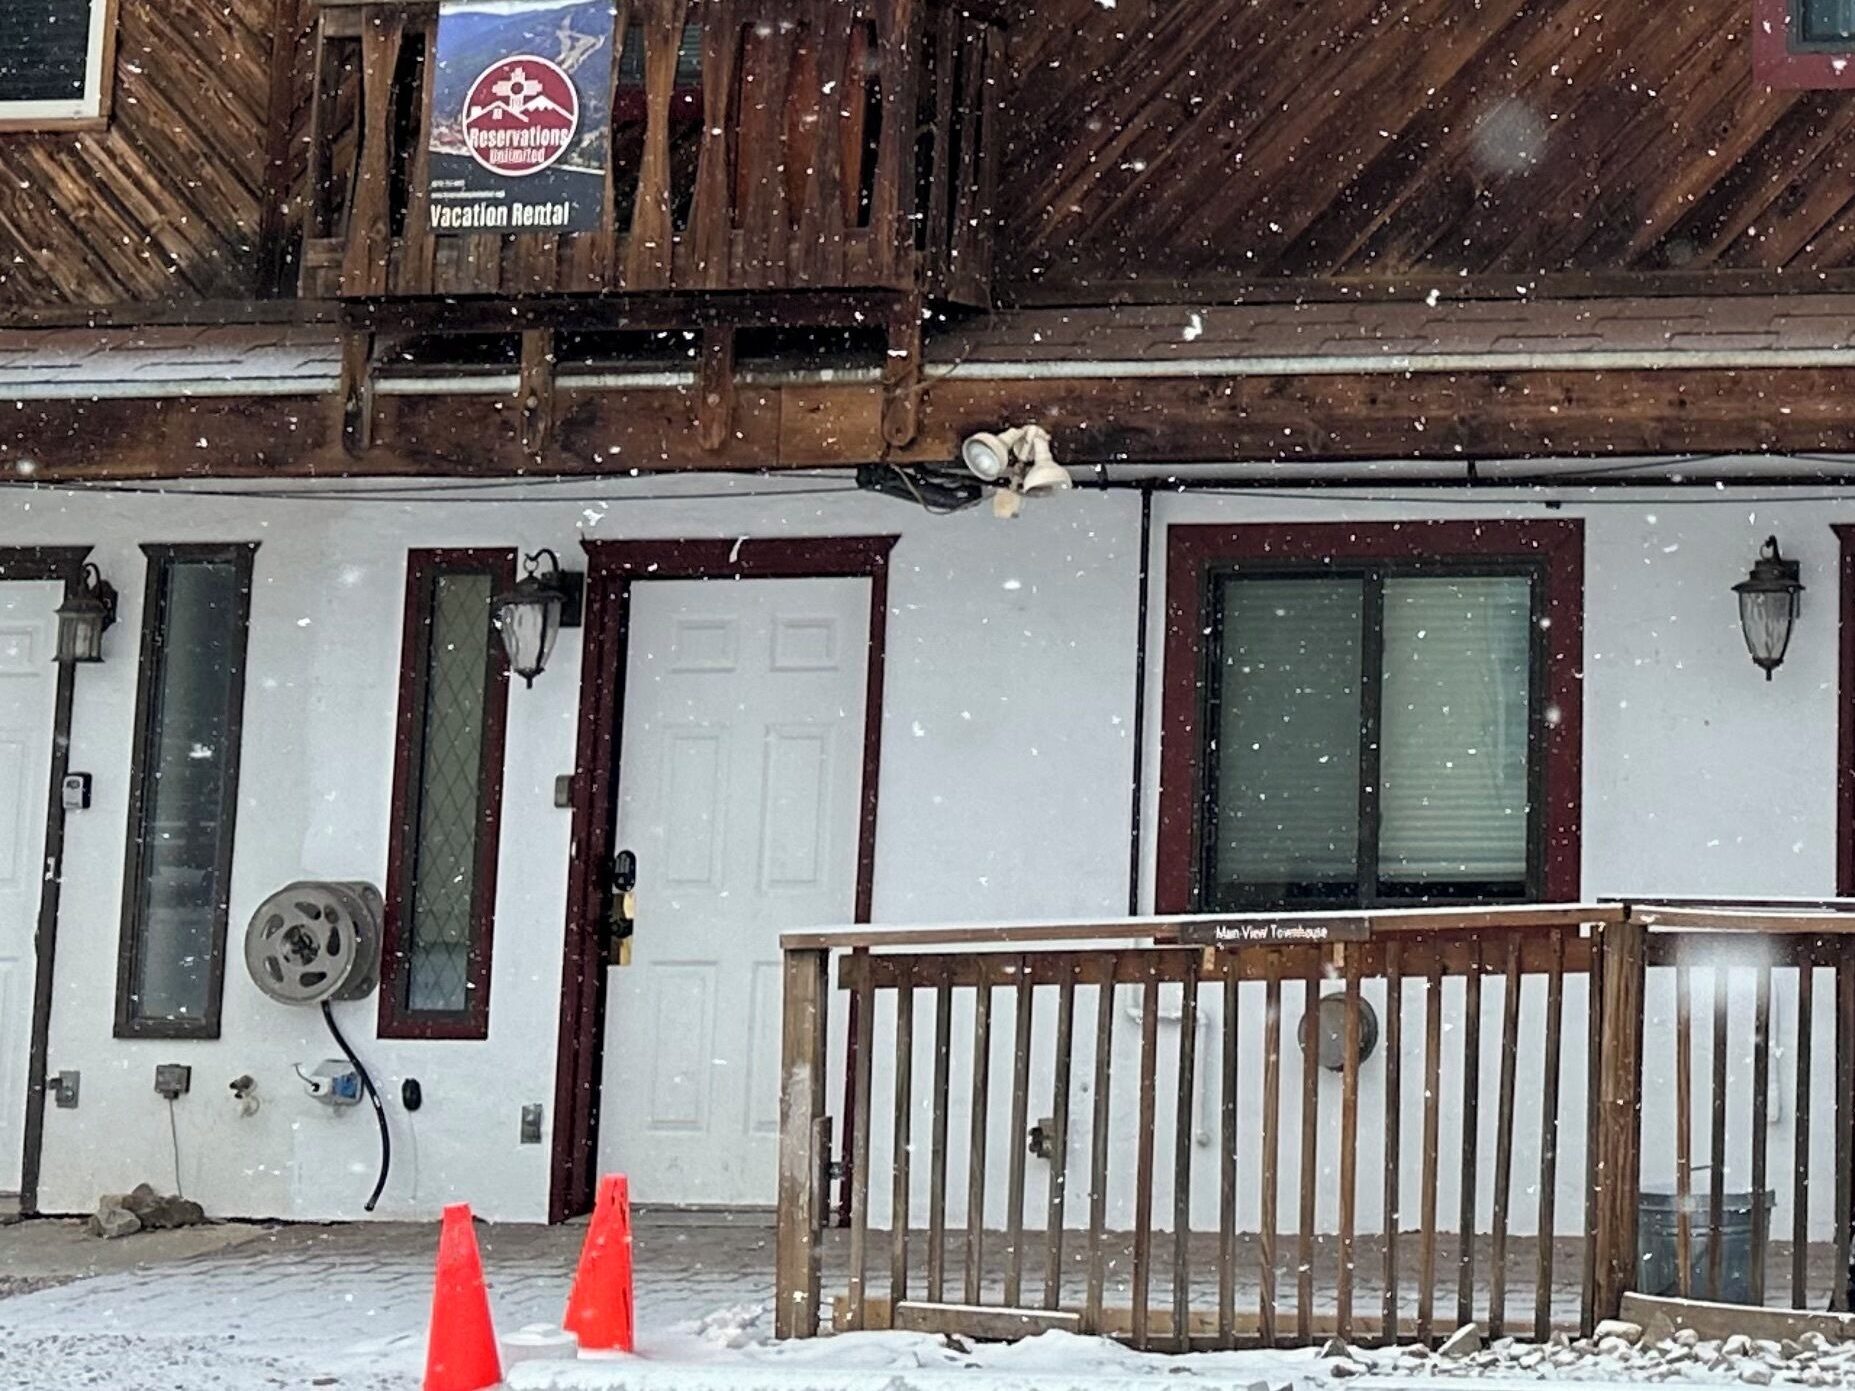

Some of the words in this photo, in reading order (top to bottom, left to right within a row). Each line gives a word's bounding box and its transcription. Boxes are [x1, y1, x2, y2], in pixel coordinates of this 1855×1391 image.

[470, 125, 570, 148] Reservations
[489, 147, 546, 165] Unlimited
[430, 201, 508, 227] Vacation
[511, 201, 570, 226] Rental
